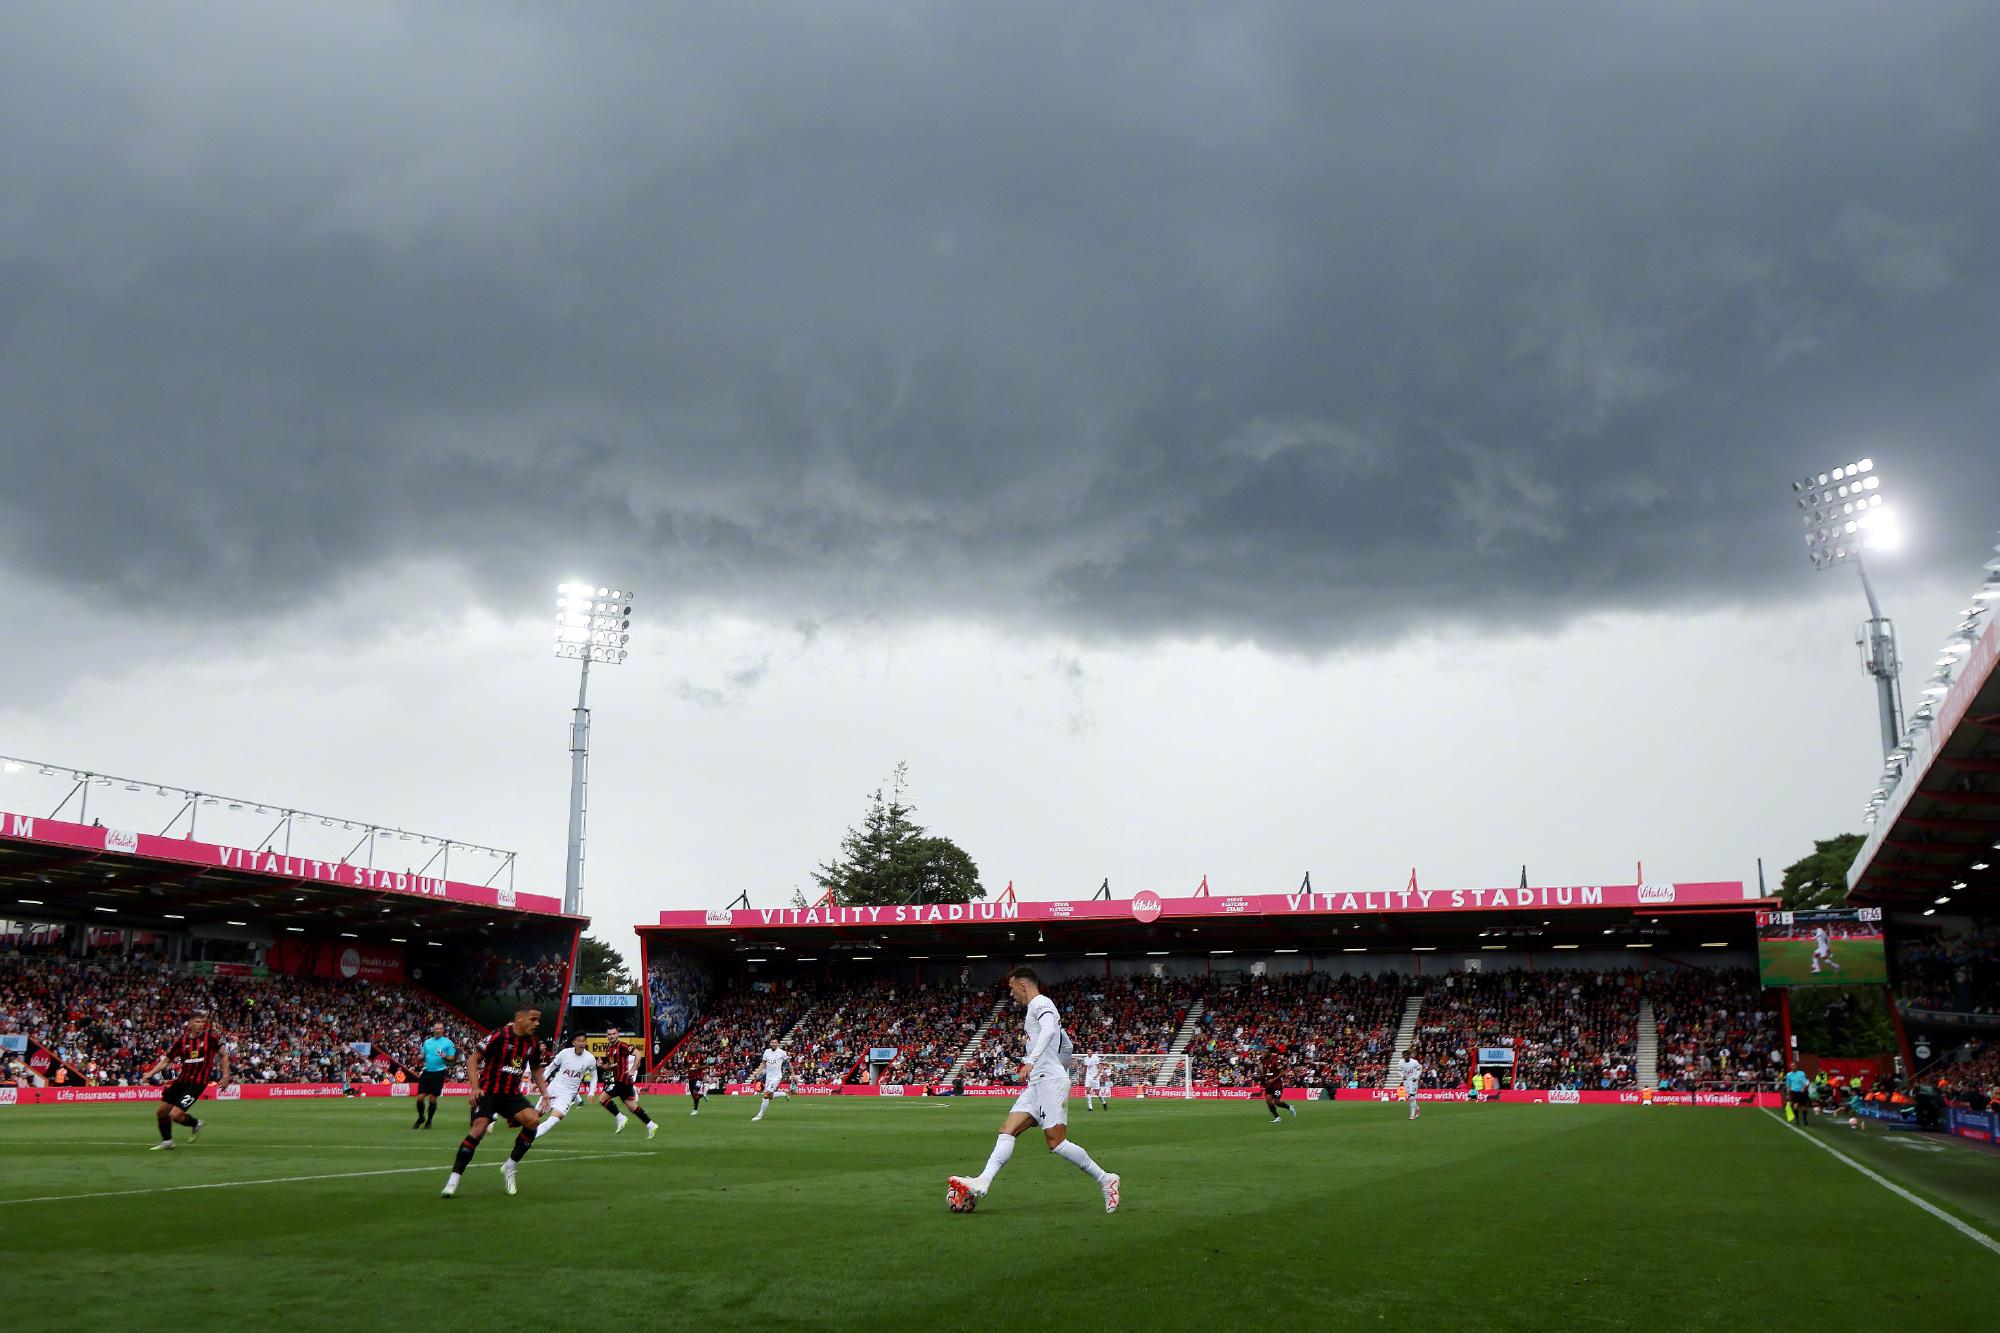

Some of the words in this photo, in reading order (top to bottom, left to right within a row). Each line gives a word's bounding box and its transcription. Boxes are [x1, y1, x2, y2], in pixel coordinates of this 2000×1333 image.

[218, 846, 340, 882] VITALITY
[353, 866, 447, 897] STADIUM
[1639, 883, 1675, 901] Vitality
[1286, 890, 1434, 912] VITALITY
[1450, 886, 1603, 908] STADIUM
[1132, 898, 1161, 915] Vitality
[706, 911, 732, 924] Vitality
[760, 906, 881, 925] VITALITY
[895, 902, 1019, 922] STADIUM
[598, 995, 607, 1006] KIT
[563, 1069, 581, 1079] AIA
[270, 1087, 283, 1096] Life
[741, 1083, 755, 1093] Life
[806, 1086, 833, 1096] Vitality
[988, 1087, 1005, 1095] with
[1161, 1088, 1200, 1097] insurace
[1223, 1089, 1253, 1099] Vitality
[57, 1090, 75, 1100] Life
[76, 1090, 116, 1100] insurance
[119, 1089, 137, 1099] with
[139, 1089, 163, 1099] Vitalit
[1372, 1090, 1388, 1099] Life
[1434, 1090, 1454, 1100] with
[1549, 1090, 1579, 1103] Vitality
[1620, 1093, 1639, 1102] Life
[1681, 1093, 1702, 1103] wih
[1705, 1094, 1742, 1106] Vitality
